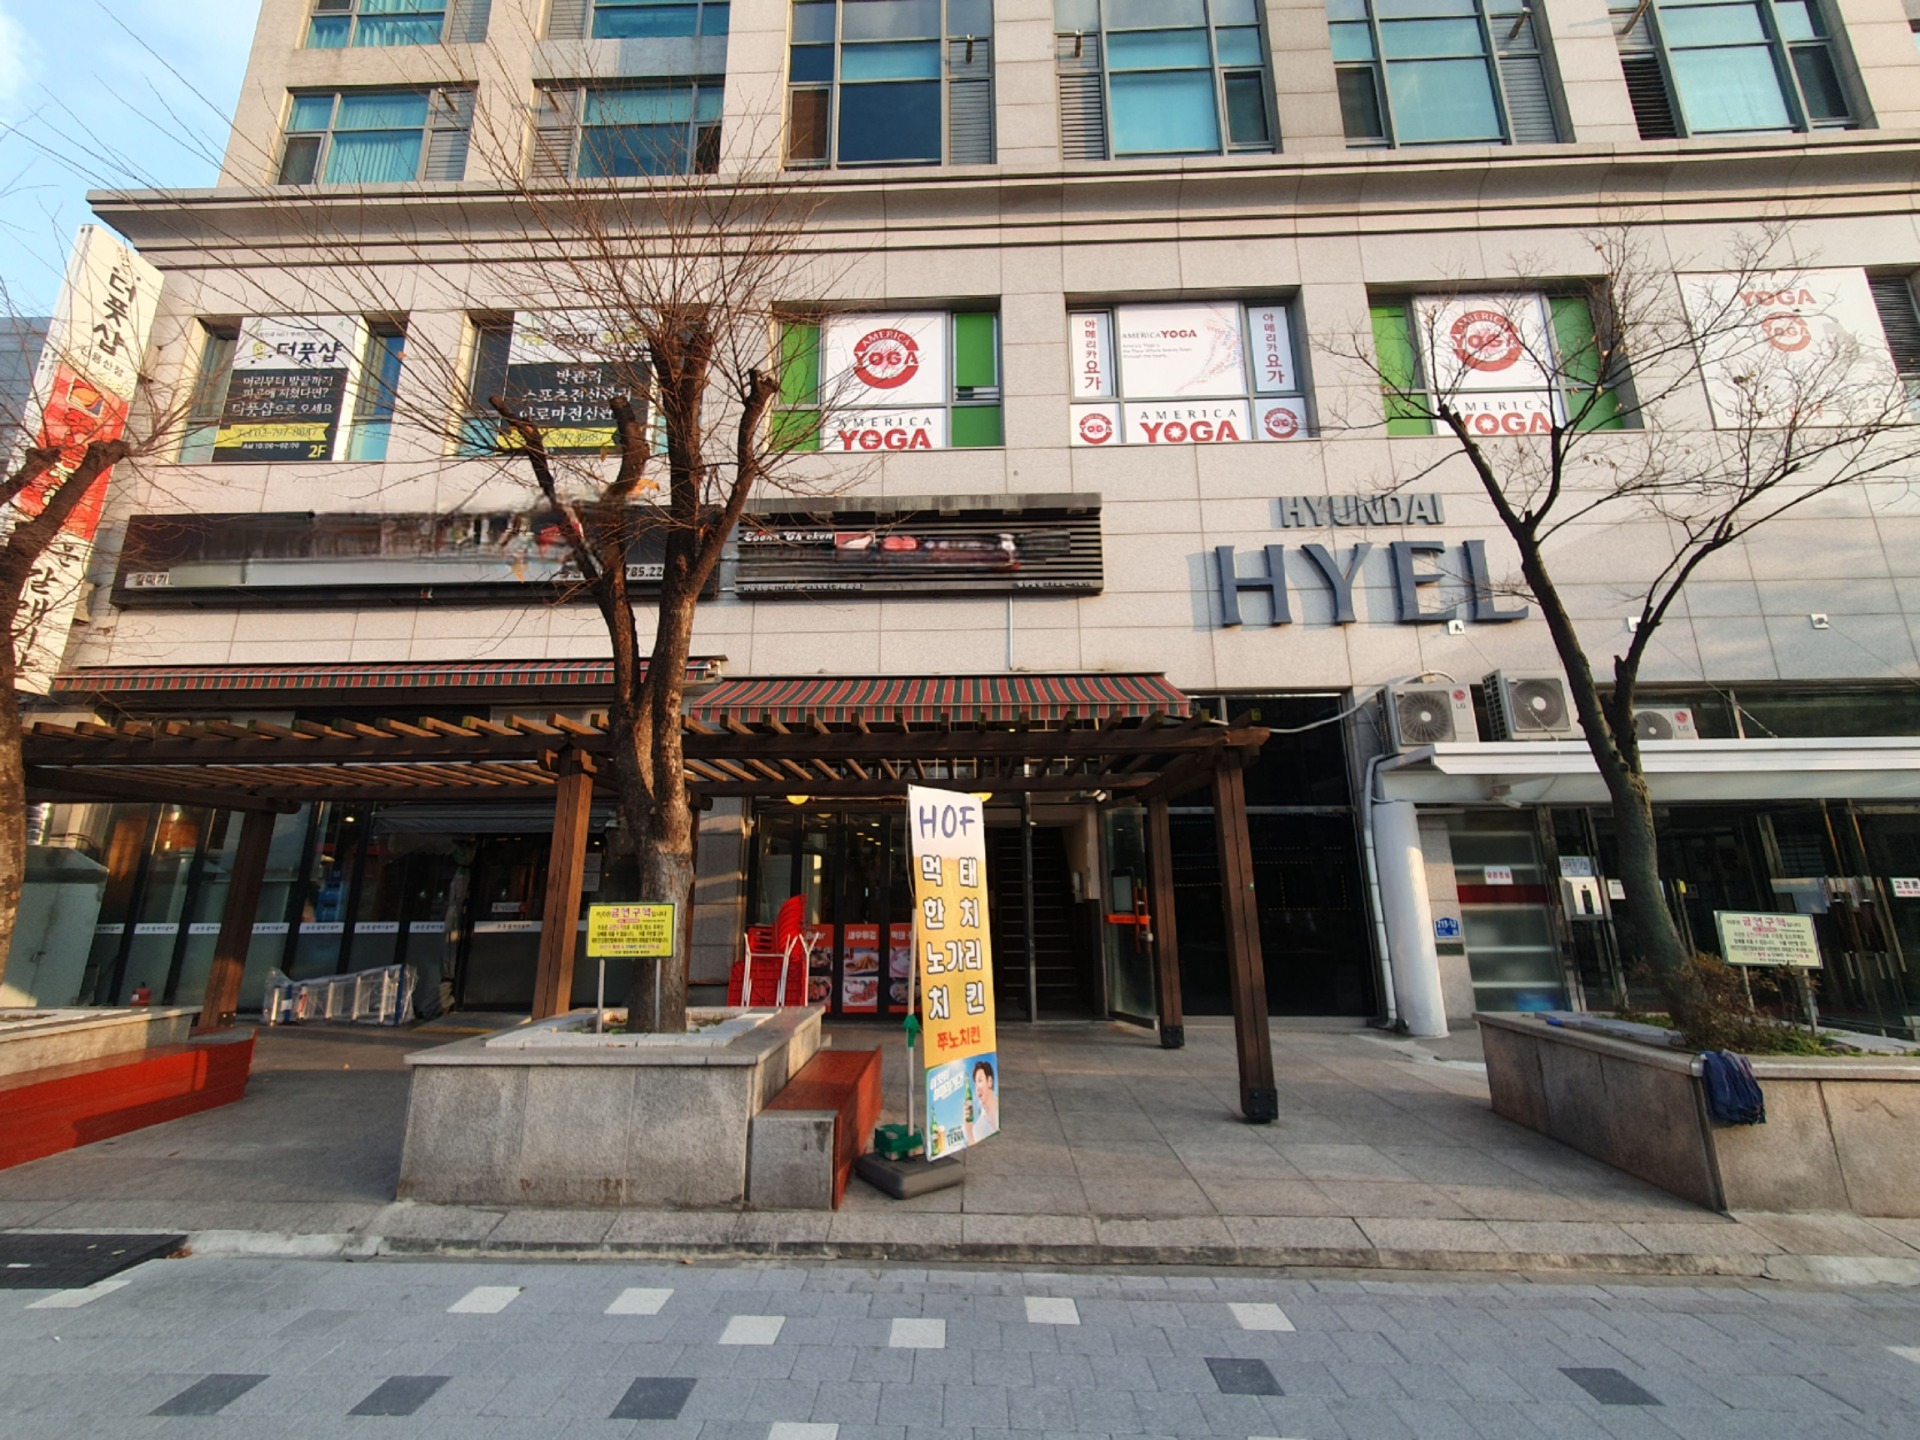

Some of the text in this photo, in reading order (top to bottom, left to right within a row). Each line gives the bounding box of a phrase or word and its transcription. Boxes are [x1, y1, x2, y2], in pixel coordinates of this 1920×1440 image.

[1738, 289, 1817, 307] YOGA
[92, 270, 137, 357] 더풋샵
[862, 330, 911, 347] AMERICA
[1161, 329, 1198, 339] YOGA
[1450, 334, 1522, 350] YOGA
[276, 341, 342, 363] 더풋샵
[854, 351, 919, 367] YOGA
[243, 376, 286, 387] 머리부터
[300, 403, 333, 415] 오세요
[1140, 408, 1238, 419] AMERICA
[1450, 400, 1550, 412] AMERICA
[837, 417, 932, 428] AMERICA
[837, 428, 932, 450] YOGA
[1139, 420, 1239, 443] YOGA
[308, 444, 327, 458] 2F
[1278, 492, 1445, 527] HYUNDAI
[783, 531, 833, 541] Chcken
[1214, 539, 1529, 626] HYEL
[919, 804, 976, 839] HOF
[926, 937, 983, 974] 노가리
[937, 1025, 981, 1051] 쭈노치킨
